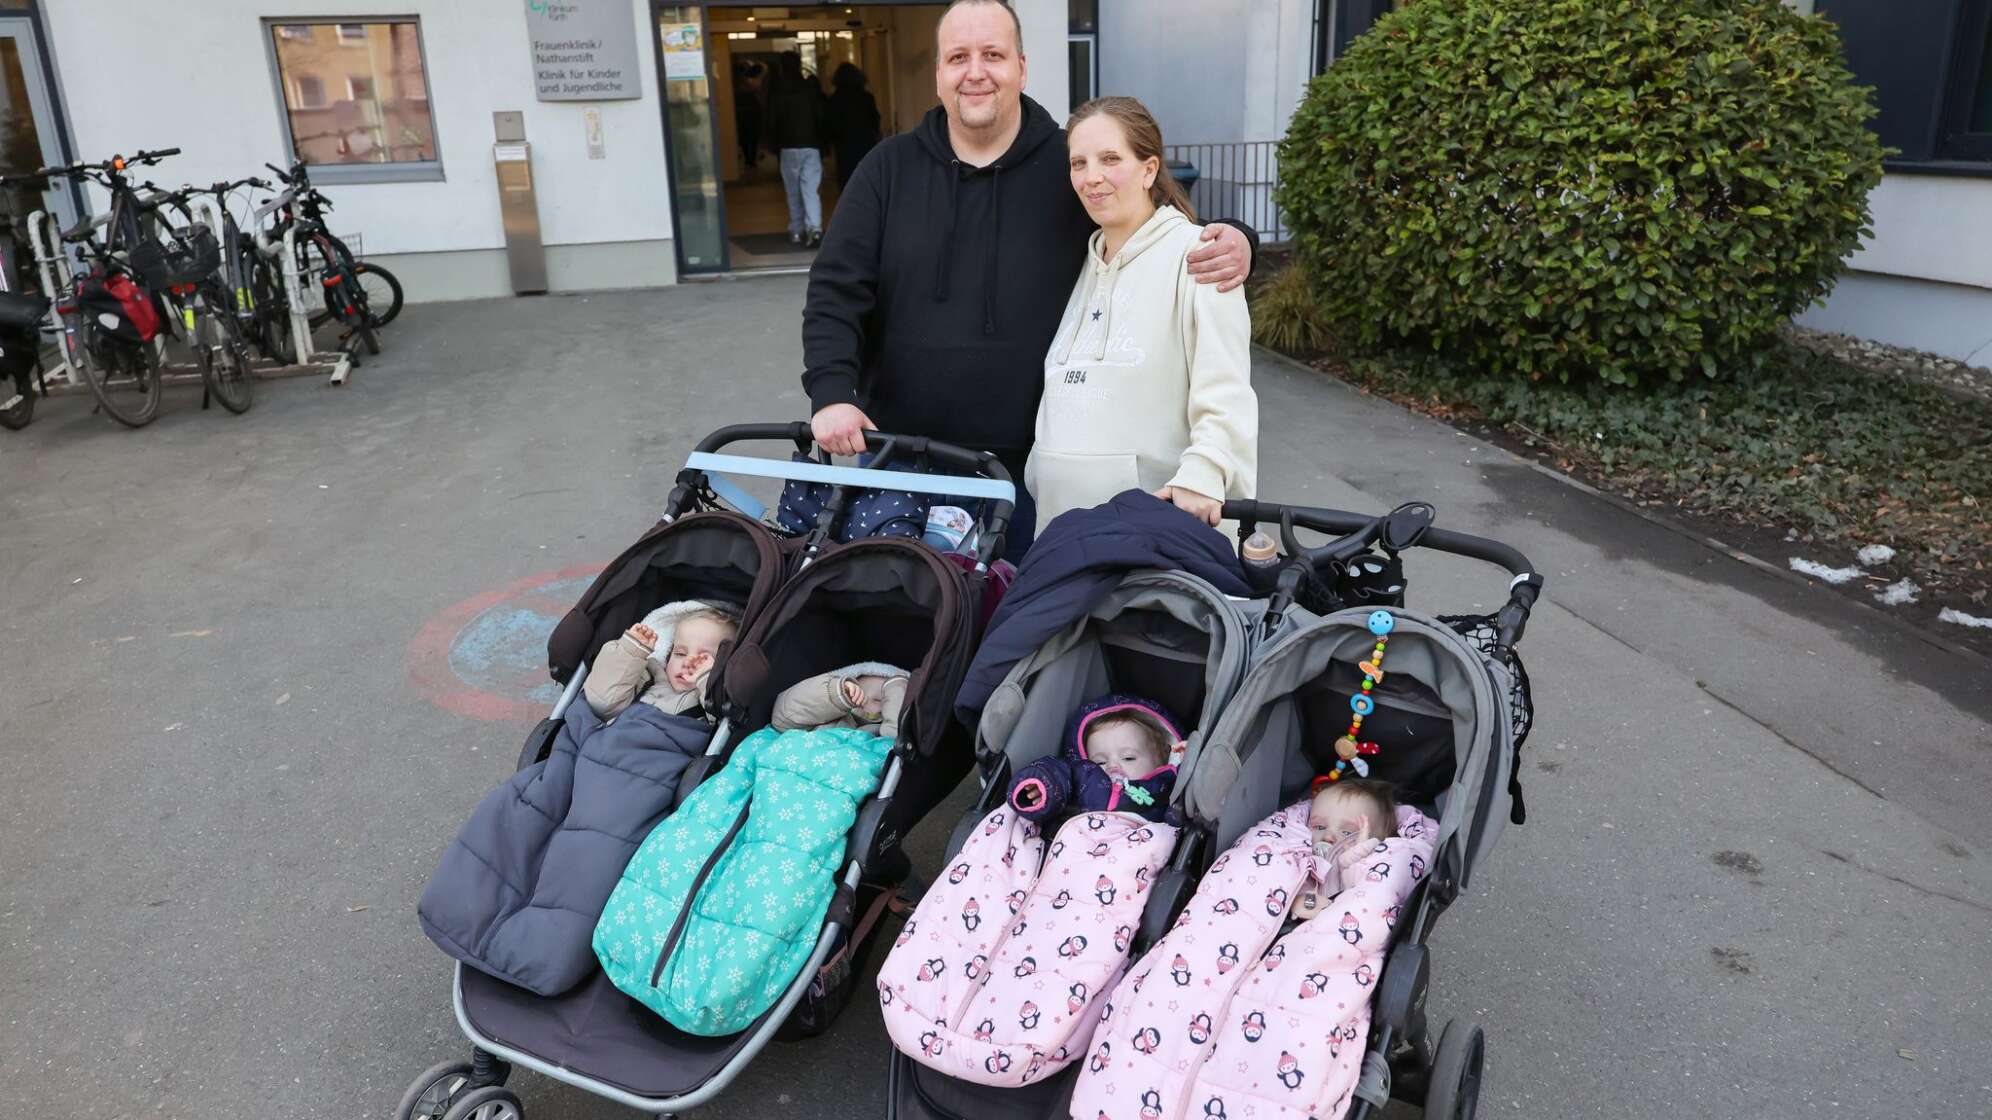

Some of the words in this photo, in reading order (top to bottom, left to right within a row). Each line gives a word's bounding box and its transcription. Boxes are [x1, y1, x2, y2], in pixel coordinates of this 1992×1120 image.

[536, 53, 594, 63] Nathanstift
[539, 70, 566, 80] Klinik
[570, 70, 584, 79] für
[588, 69, 621, 79] Kinder
[540, 83, 560, 93] und
[563, 82, 622, 95] Jugendliche
[1064, 371, 1087, 384] 1994
